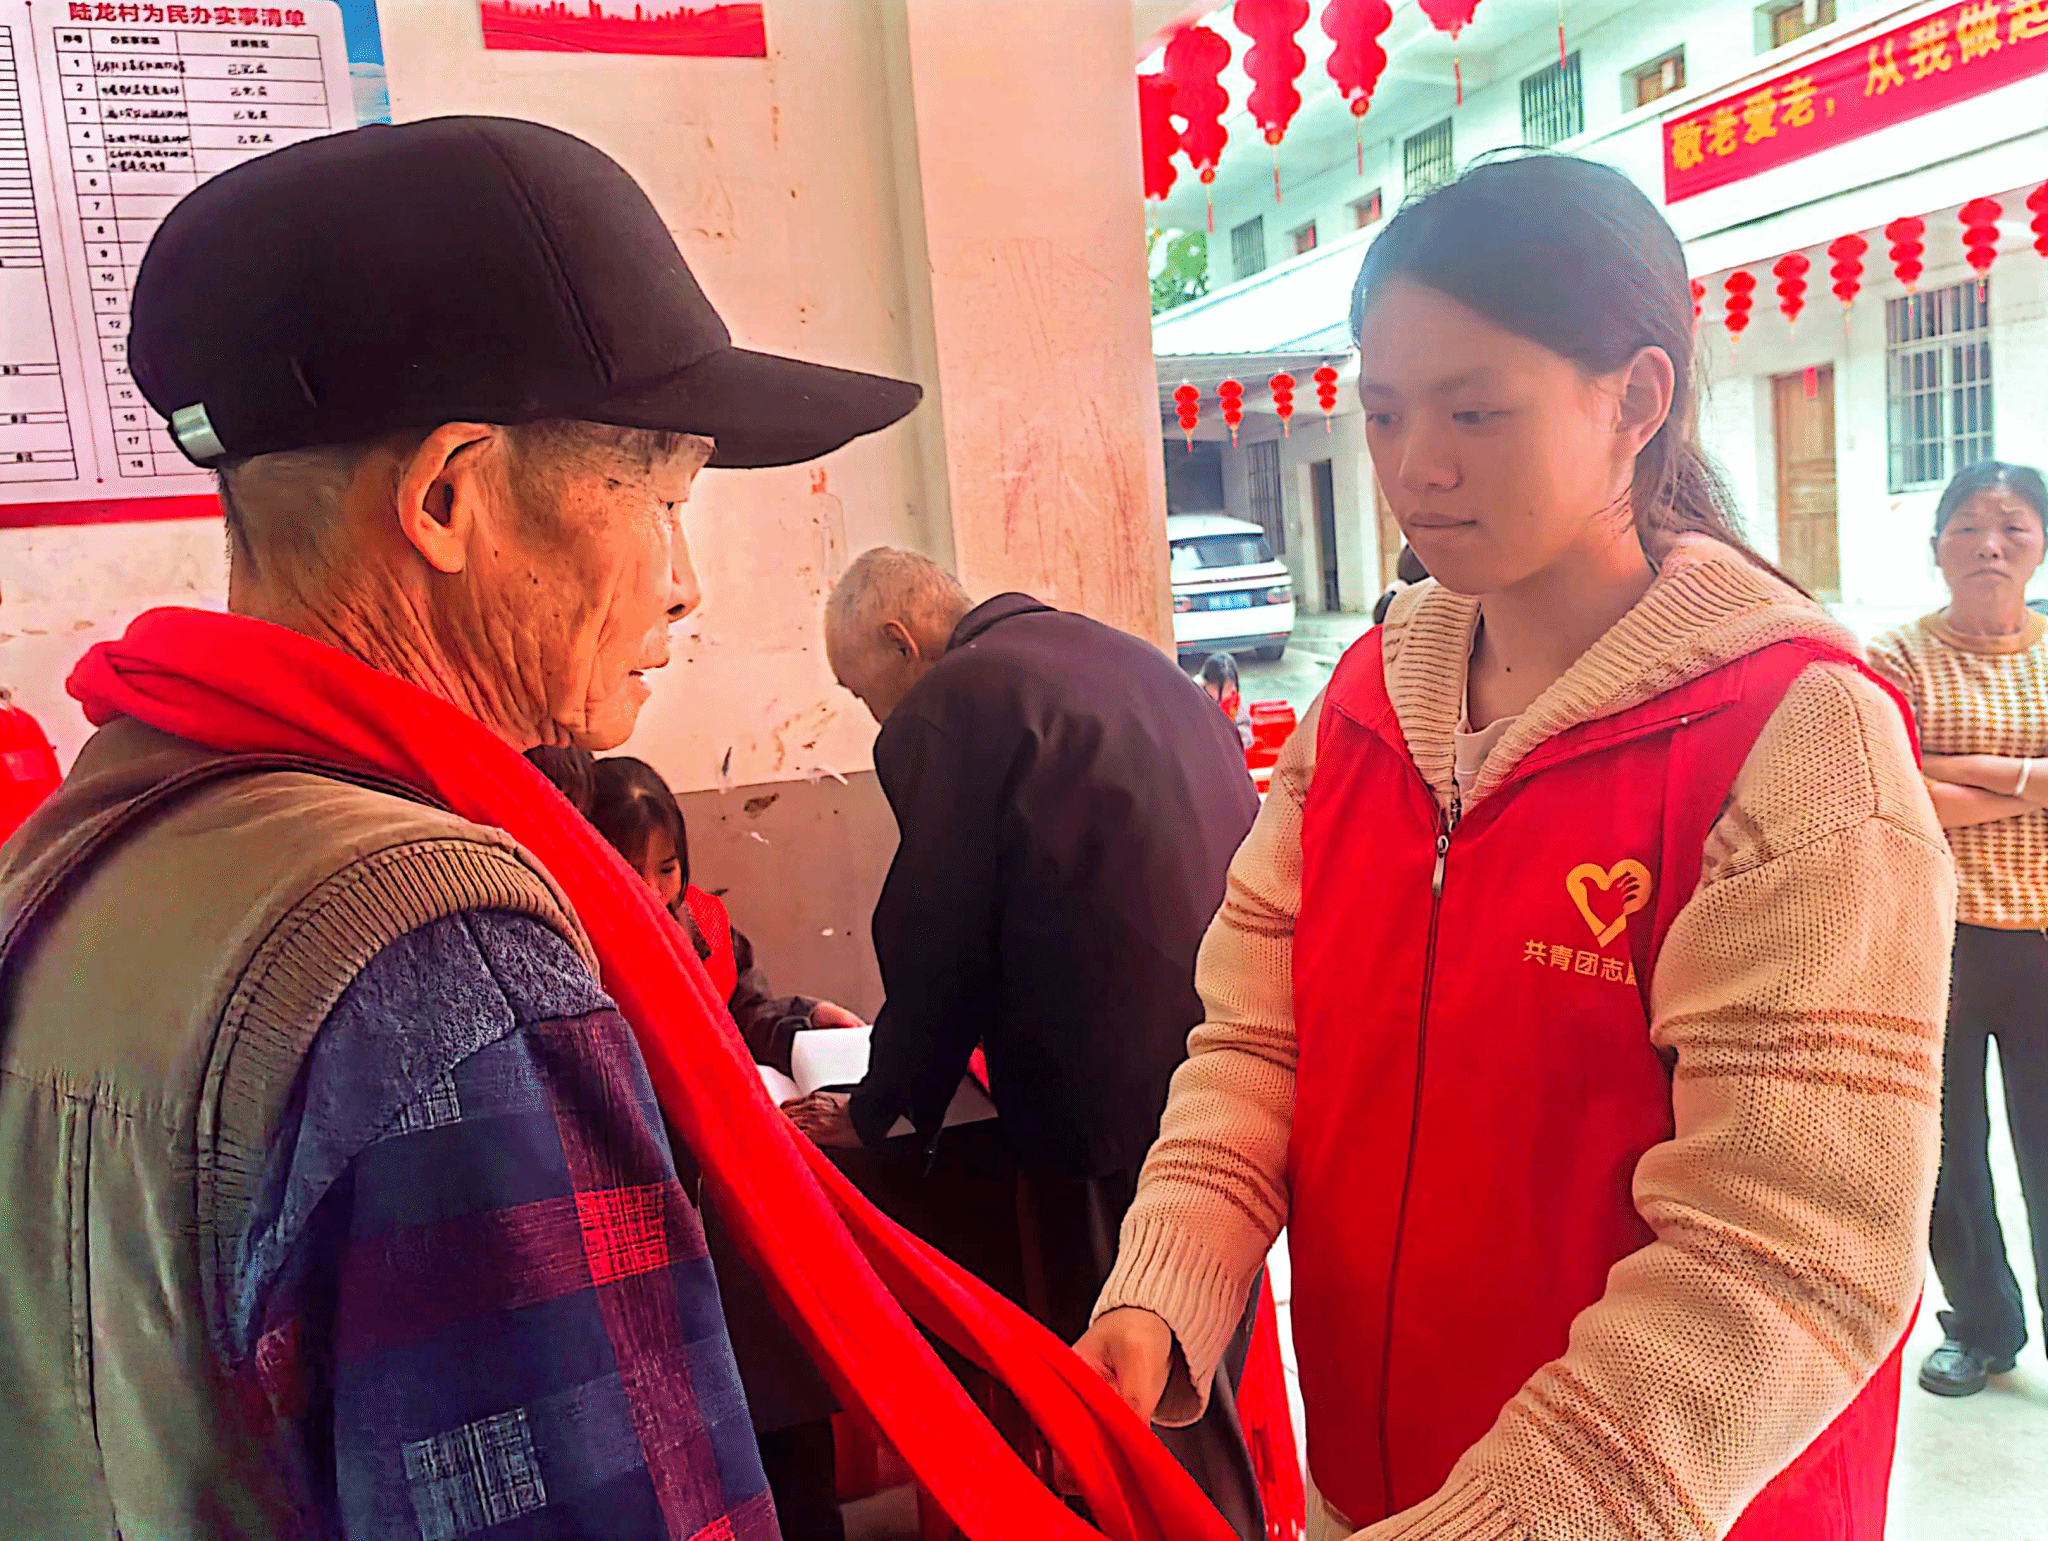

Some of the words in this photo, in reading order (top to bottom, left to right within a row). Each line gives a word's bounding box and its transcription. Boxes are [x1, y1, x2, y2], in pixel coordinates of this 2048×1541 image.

[67, 1, 307, 28] 陆龙村为民办实事清单
